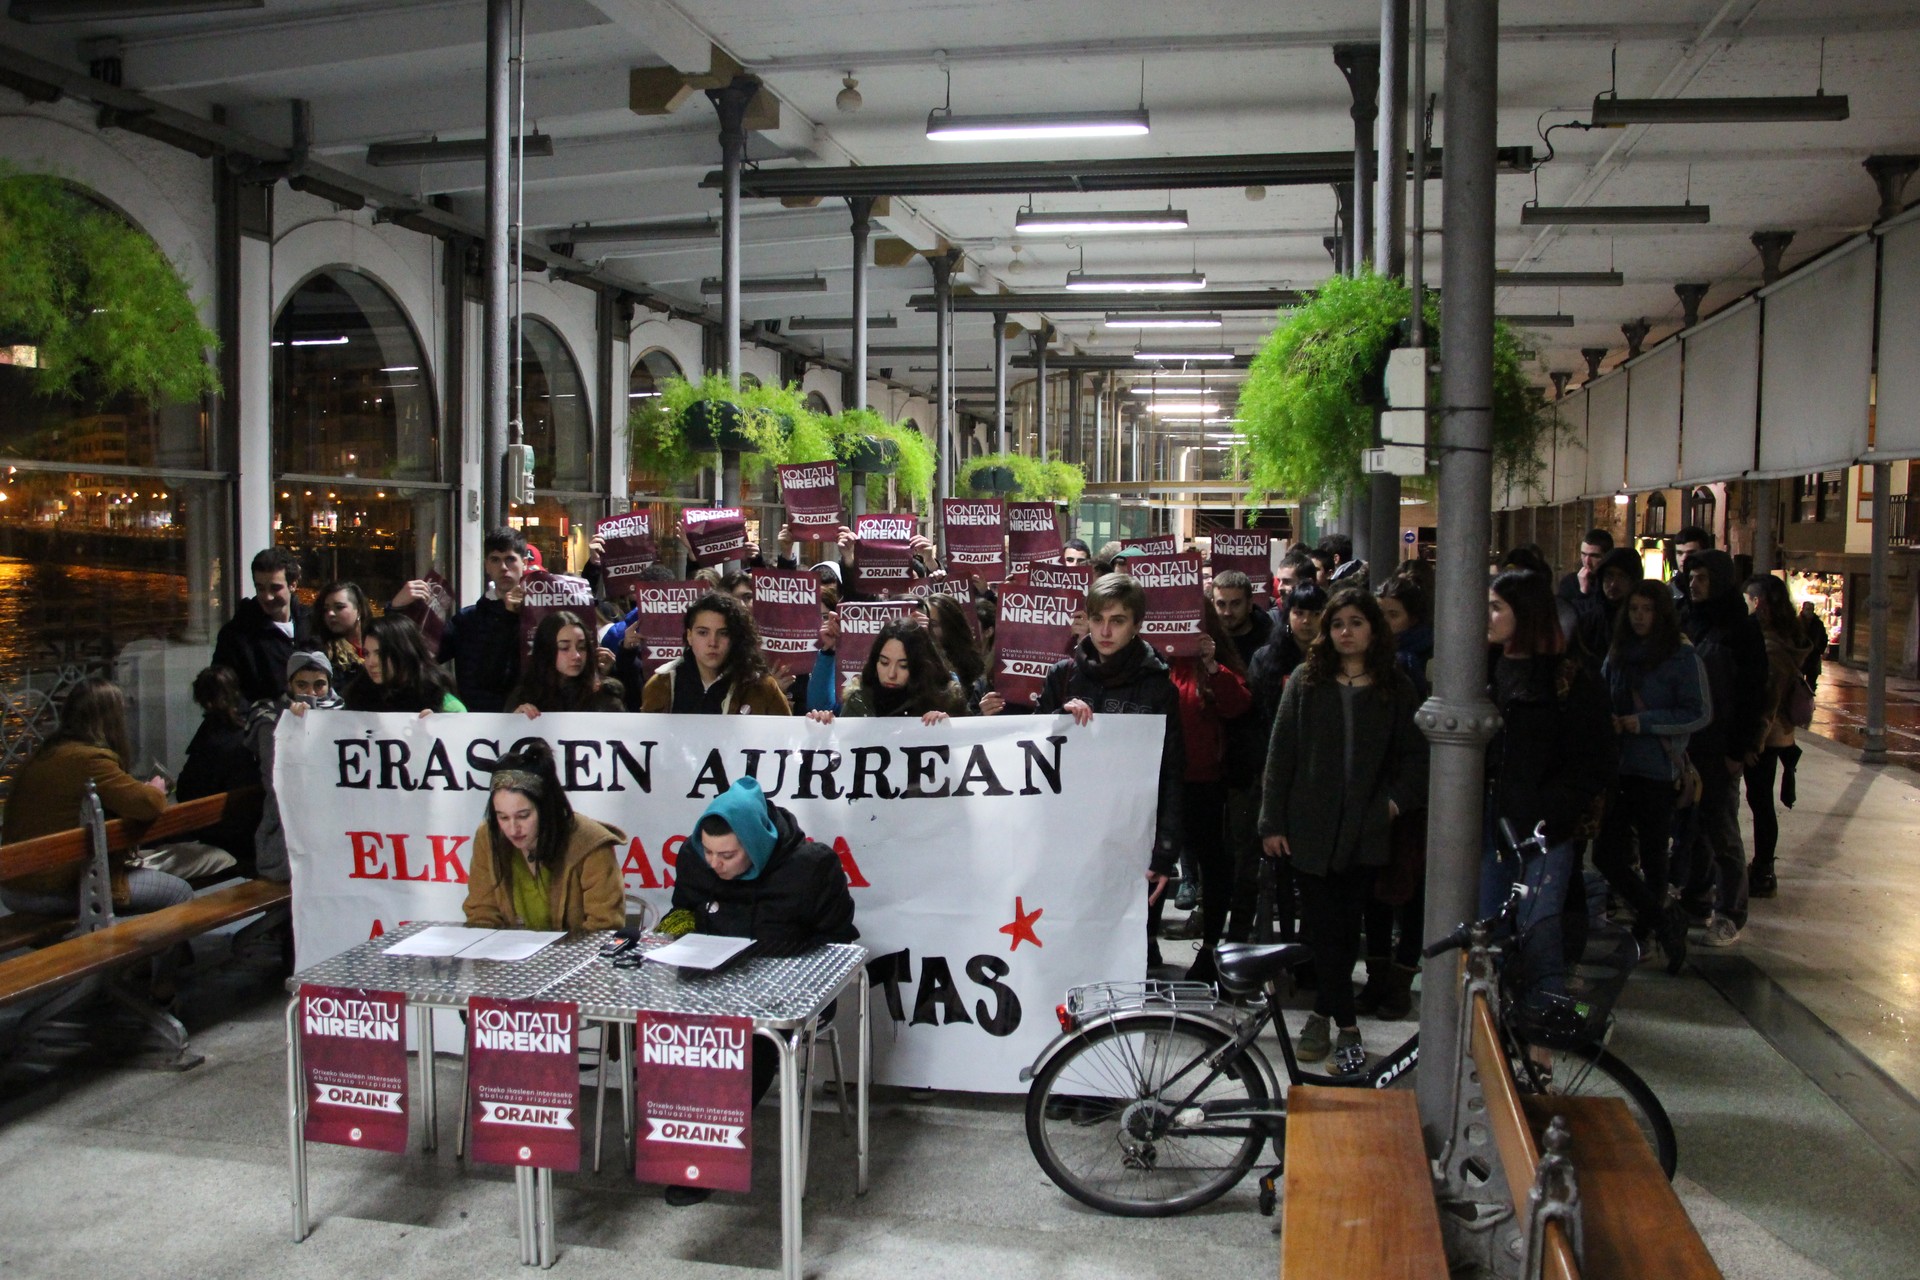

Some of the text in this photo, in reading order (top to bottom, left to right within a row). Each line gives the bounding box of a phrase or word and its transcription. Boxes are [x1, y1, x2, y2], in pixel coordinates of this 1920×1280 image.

[782, 466, 834, 480] KONTATU
[784, 476, 835, 489] NIREKIN
[946, 505, 1000, 515] KONTATU
[1009, 508, 1052, 520] KONTATU
[599, 515, 648, 532] KONTATU
[798, 514, 831, 524] ORAIN!
[860, 519, 912, 531] KONTATU
[947, 515, 1001, 525] NIREKIN
[1010, 519, 1054, 531] NIREKIN
[858, 529, 911, 540] NIREKIN
[1214, 533, 1268, 546] KONTATU
[705, 540, 739, 553] ORAIN!
[1214, 544, 1267, 556] NIREKIN
[958, 554, 994, 562] ORAIN!
[866, 569, 902, 577] ORAIN!
[1132, 560, 1198, 577] KONTATU
[755, 575, 817, 592] KONTATU
[1030, 569, 1089, 585] KONTATU
[524, 581, 588, 595] KONTATU
[525, 594, 591, 606] NIREKIN
[755, 588, 816, 605] NIREKIN
[1002, 593, 1077, 612] KONTATU
[1001, 607, 1075, 626] NIREKIN
[840, 620, 885, 634] NIRE
[1147, 622, 1191, 632] ORAIN!
[767, 639, 808, 651] ORAIN!
[1012, 662, 1050, 676] ORAI
[334, 735, 1069, 801] ERASEN AURREAN
[306, 996, 399, 1022] KONTATU
[306, 1016, 399, 1041] NIREKIN
[475, 1009, 572, 1034] KONTATU
[475, 1029, 570, 1054] NIREKIN
[643, 1022, 745, 1049] KONTATU
[644, 1043, 744, 1070] NIREKIN
[313, 1068, 402, 1084] Orixeko ikasleen intereseko
[313, 1075, 402, 1090] ebaluazio irizpideak
[328, 1088, 389, 1108] ORAIN!
[479, 1085, 573, 1099] Orixeko ikasleen intereseko
[479, 1093, 573, 1105] ebaluazio irizpideak
[494, 1106, 558, 1125] ORAIN!
[647, 1101, 745, 1117] Orixeko ikasleen intereseko
[647, 1109, 744, 1123] ebaluazio irizpideak
[661, 1123, 729, 1143] ORAIN!
